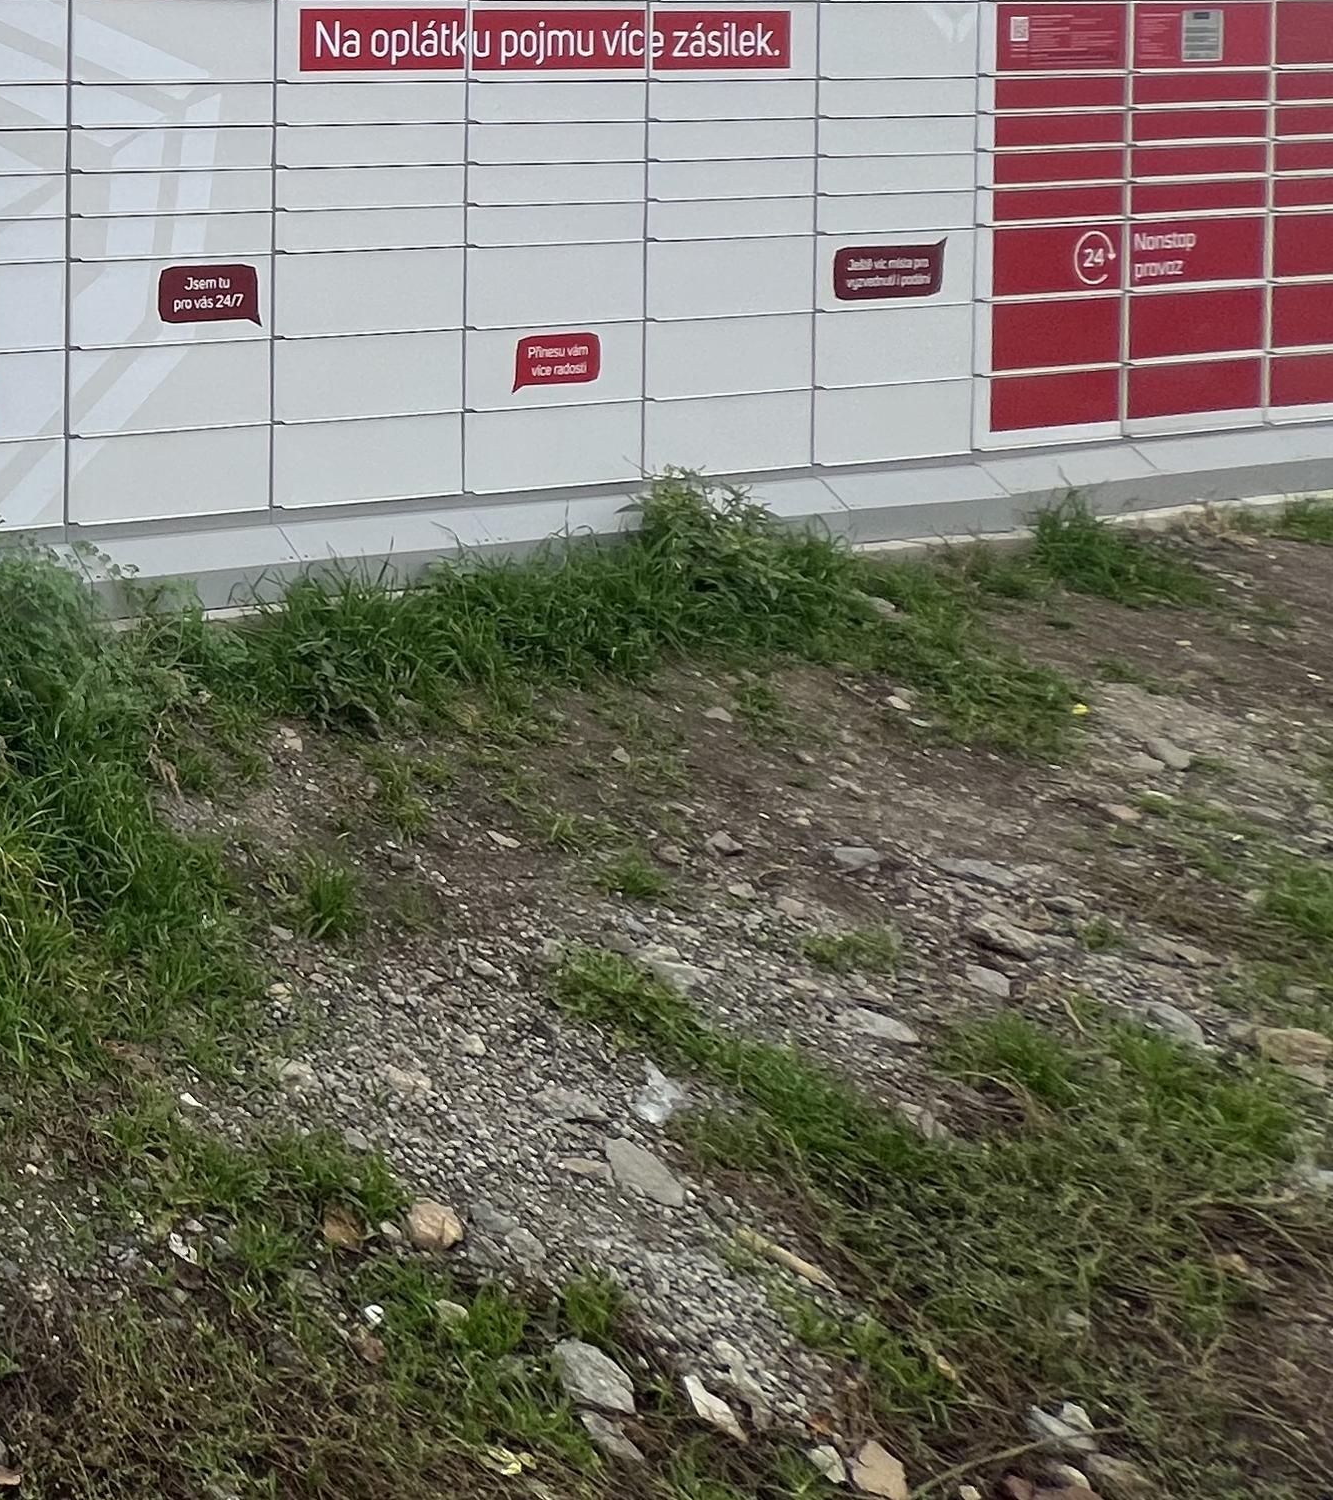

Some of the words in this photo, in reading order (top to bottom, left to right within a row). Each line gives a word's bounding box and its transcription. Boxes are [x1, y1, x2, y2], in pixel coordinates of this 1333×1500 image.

[315, 20, 361, 58] Na
[371, 22, 491, 68] oplátku
[501, 25, 594, 71] pojmu
[601, 24, 663, 59] více
[672, 22, 781, 60] zásilek.
[1134, 232, 1196, 252] Nonstop
[1083, 248, 1104, 267] 24
[1135, 260, 1184, 281] provoz
[184, 277, 216, 290] Jsem
[218, 277, 231, 289] tu
[173, 298, 192, 313] pro
[194, 295, 213, 309] vás
[215, 293, 244, 308] 24/7
[567, 344, 589, 357] vám
[531, 364, 552, 377] více
